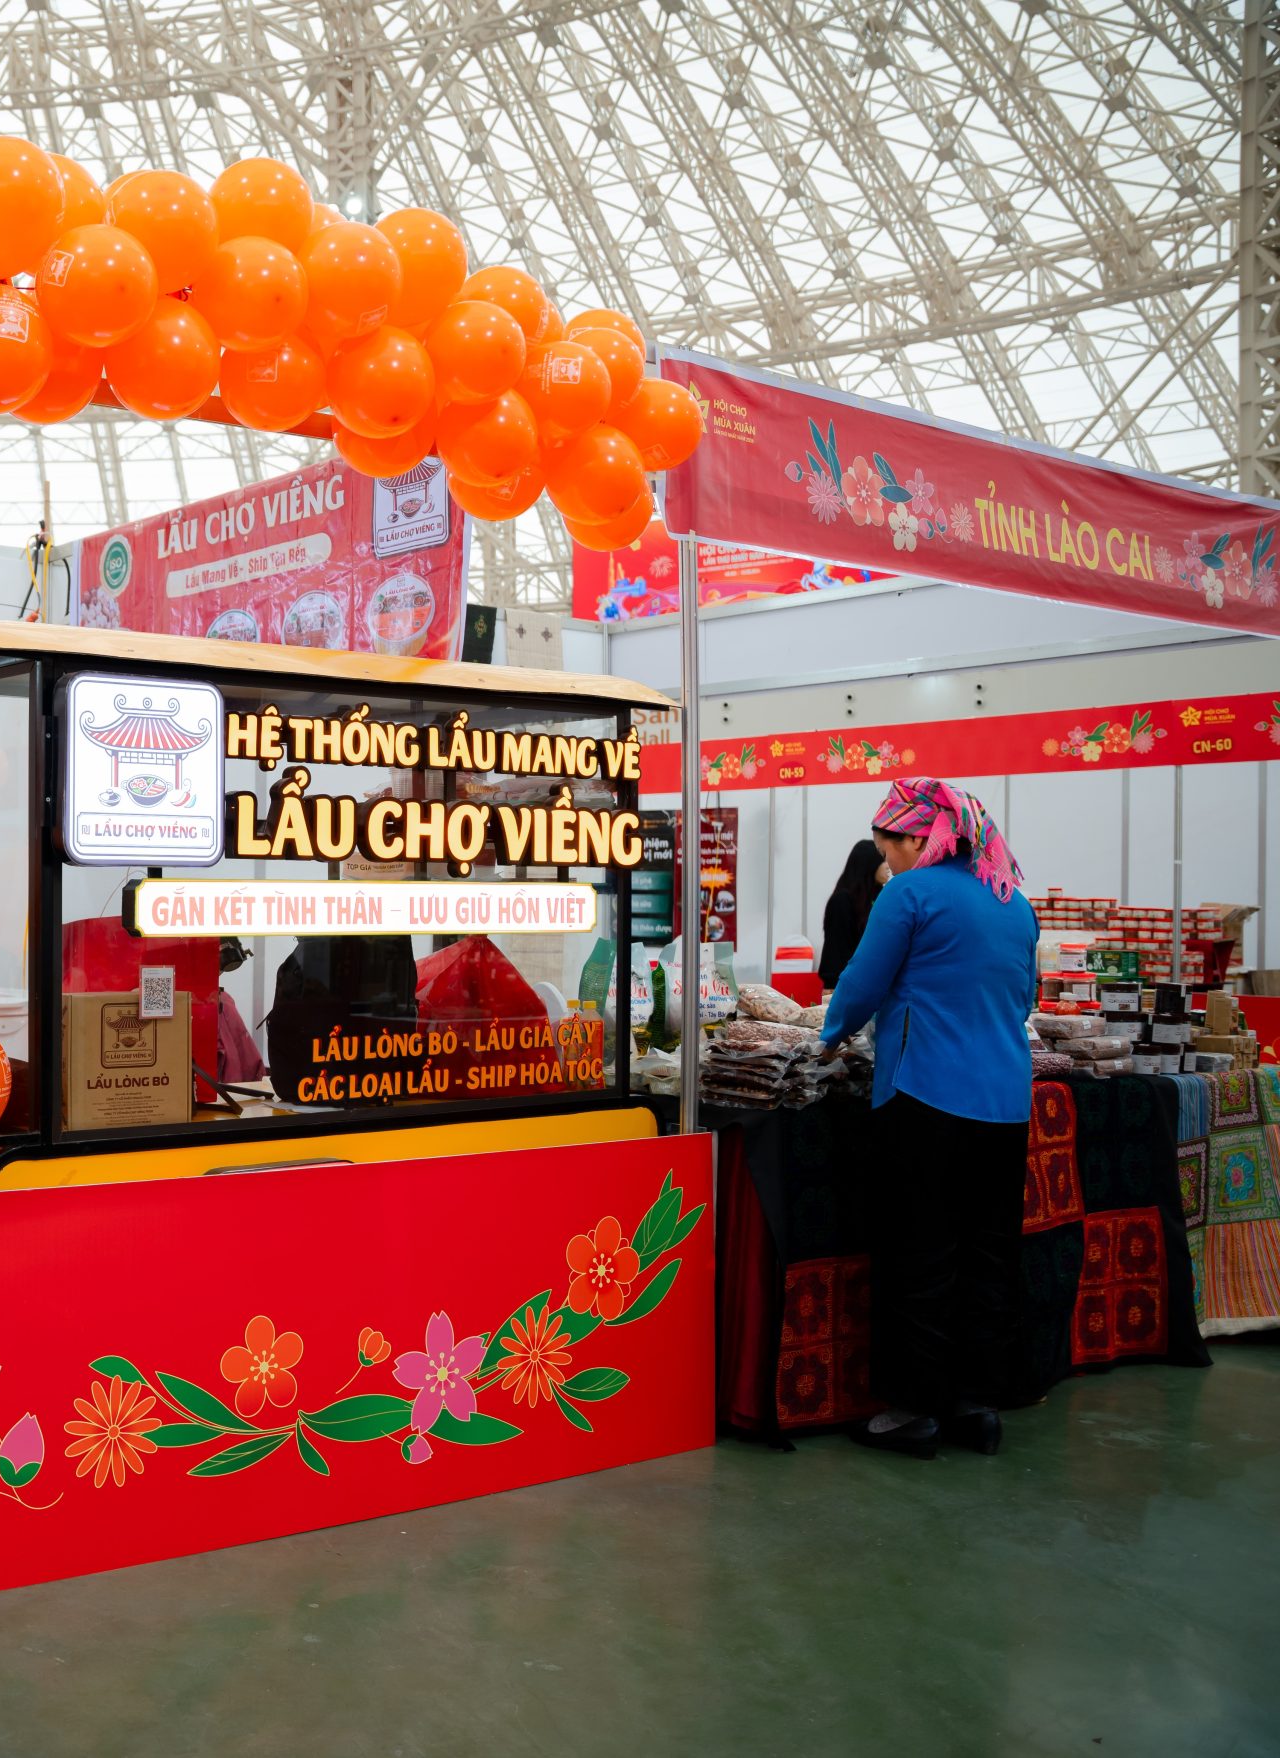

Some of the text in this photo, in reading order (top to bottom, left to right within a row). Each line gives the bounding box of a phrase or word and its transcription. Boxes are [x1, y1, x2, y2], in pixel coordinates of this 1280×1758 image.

[713, 398, 747, 420] HỘI CHỢ
[713, 414, 756, 436] MÙA XUÂN
[157, 474, 345, 559] LẨU CHỢ VIỀNG
[974, 480, 1155, 581] TỈNH LÀO CAI
[109, 557, 122, 568] ISO
[185, 573, 200, 589] Lẩu
[201, 568, 225, 586] Mang
[228, 560, 238, 579] Về
[248, 558, 268, 575] Ship
[288, 545, 306, 563] Bếp
[227, 704, 641, 779] HỆ THỐNG LẨU MANG VỀ
[1193, 738, 1232, 753] CN-60
[779, 767, 805, 779] CN-59
[94, 818, 122, 837] LẨU
[125, 824, 156, 841] CHỢ
[237, 769, 642, 875] LẨU CHỢ VIỀNG
[347, 863, 358, 871] TOP
[151, 886, 205, 927] GẮN
[214, 886, 256, 926] KẾT
[262, 890, 317, 926] TÌNH
[323, 889, 383, 925] THÂN
[409, 892, 448, 925] LƯU
[455, 892, 494, 925] GIỮ
[498, 888, 540, 924] HỒN
[546, 891, 586, 928] VIỆT
[312, 1024, 359, 1063] LẨU
[364, 1027, 423, 1060] LÒNG
[428, 1025, 458, 1056] BÒ
[474, 1017, 515, 1053] LẨU
[520, 1017, 554, 1049] GIẢ
[558, 1012, 596, 1047] CẦY
[86, 1073, 170, 1090] LẨU LÒNG BÒ
[297, 1069, 345, 1103] CÁC
[349, 1071, 402, 1104] LOẠI
[407, 1058, 450, 1094] LẨU
[466, 1064, 517, 1090] SHIP
[520, 1054, 563, 1086] HỎA
[566, 1048, 604, 1082] TỐC
